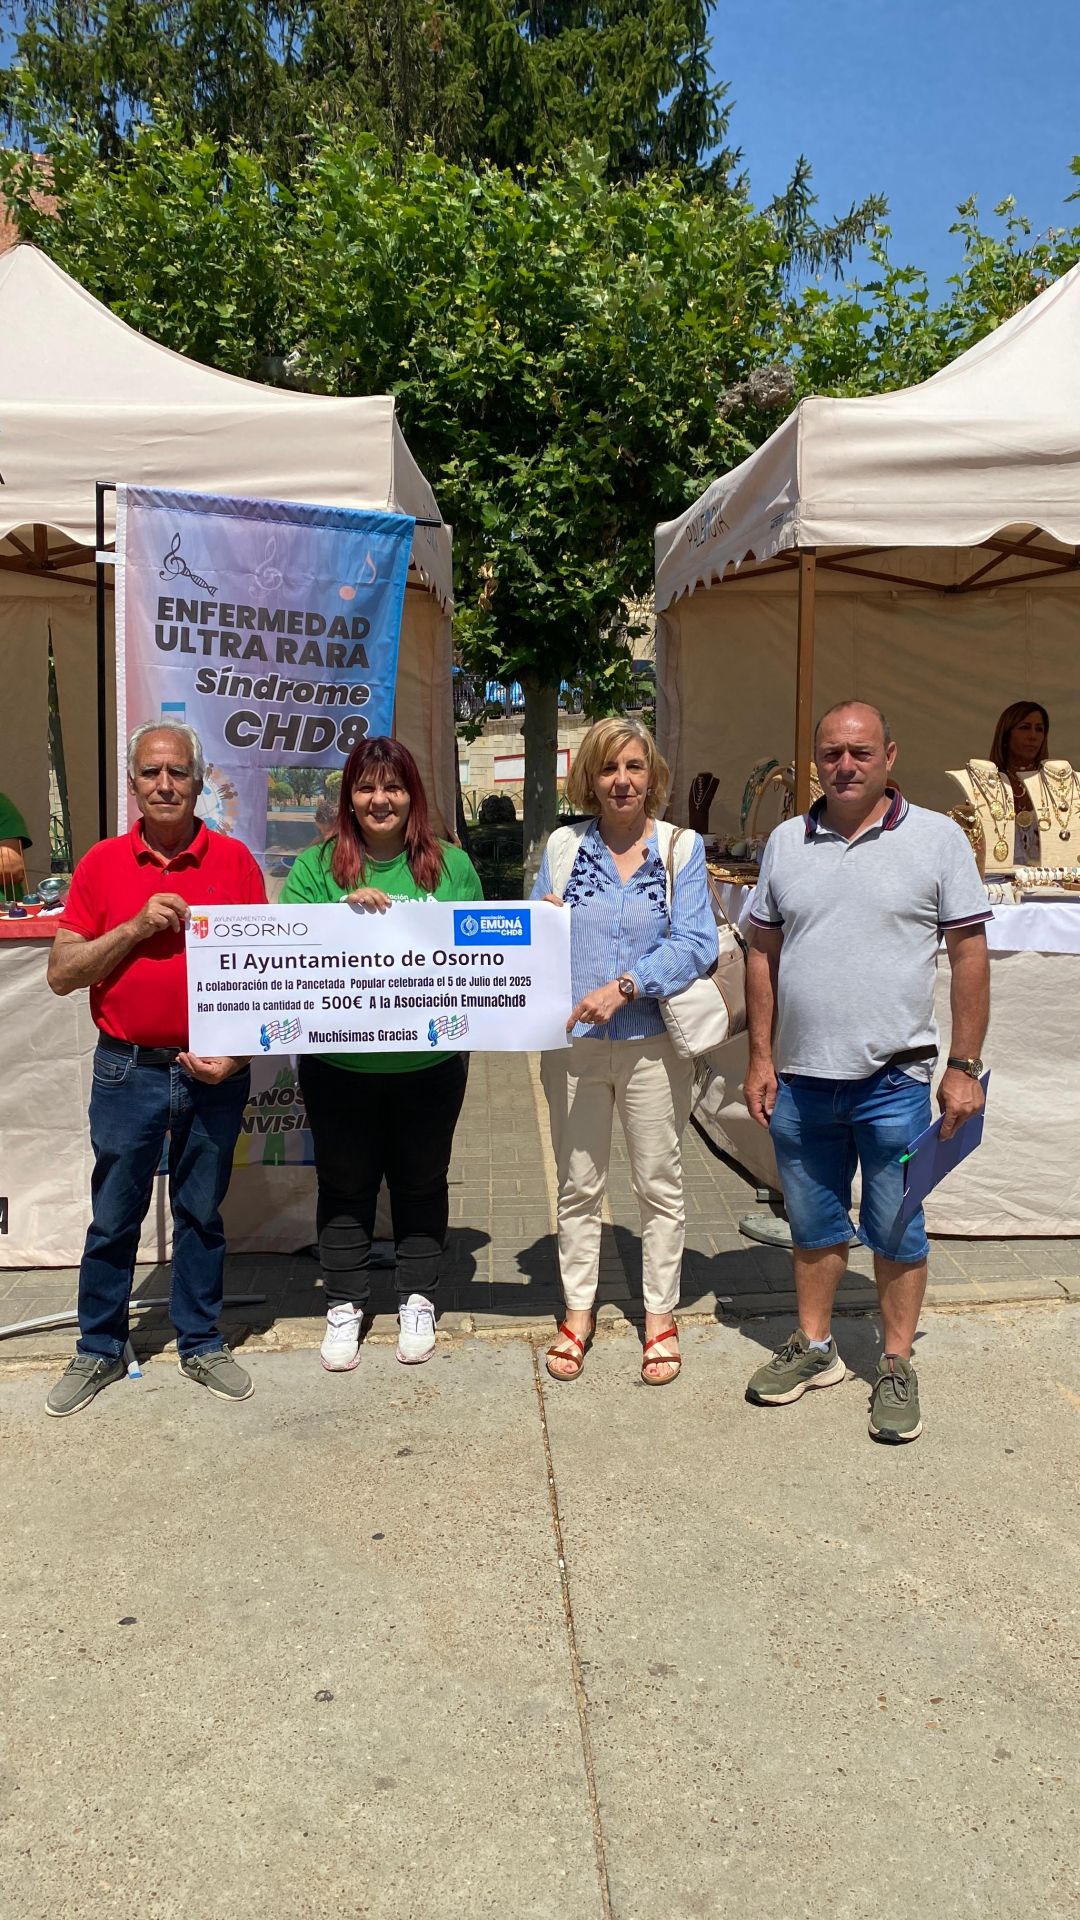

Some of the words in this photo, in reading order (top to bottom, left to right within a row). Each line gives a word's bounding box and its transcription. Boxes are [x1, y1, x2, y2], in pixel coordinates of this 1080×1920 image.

[157, 596, 371, 640] ENFERMEDAD
[155, 624, 268, 662] ULTRA
[276, 637, 370, 669] RARA
[196, 665, 370, 706] Síndrome
[224, 710, 370, 755] CHD8
[214, 923, 308, 937] OSORNO
[481, 916, 522, 929] EMUNÁ
[220, 953, 237, 970] El
[243, 950, 395, 974] Ayuntamiento
[401, 950, 426, 967] de
[432, 950, 505, 966] Osorno
[197, 981, 203, 992] A
[205, 979, 268, 992] colaboración
[271, 980, 282, 991] de
[285, 979, 293, 990] la
[296, 978, 345, 990] Pancetada
[350, 977, 386, 991] Popular
[388, 976, 434, 988] celebrada
[437, 976, 445, 987] el
[447, 976, 453, 987] 5
[455, 975, 467, 987] de
[469, 975, 491, 987] Julio
[493, 975, 507, 987] del
[509, 975, 532, 987] 2025
[197, 1002, 214, 1013] Han
[216, 1001, 250, 1012] donado
[252, 1000, 260, 1011] la
[262, 1000, 301, 1011] cantidad
[303, 1000, 315, 1010] de
[321, 996, 363, 1010] 500€
[369, 996, 377, 1009] A
[380, 995, 391, 1009] la
[394, 993, 458, 1008] Asociación
[461, 994, 526, 1008] EmunaChd8
[308, 1030, 375, 1043] Muchísimas
[378, 1028, 418, 1041] Gracias
[248, 1088, 306, 1107] ANOS
[241, 1114, 311, 1134] NVISI
